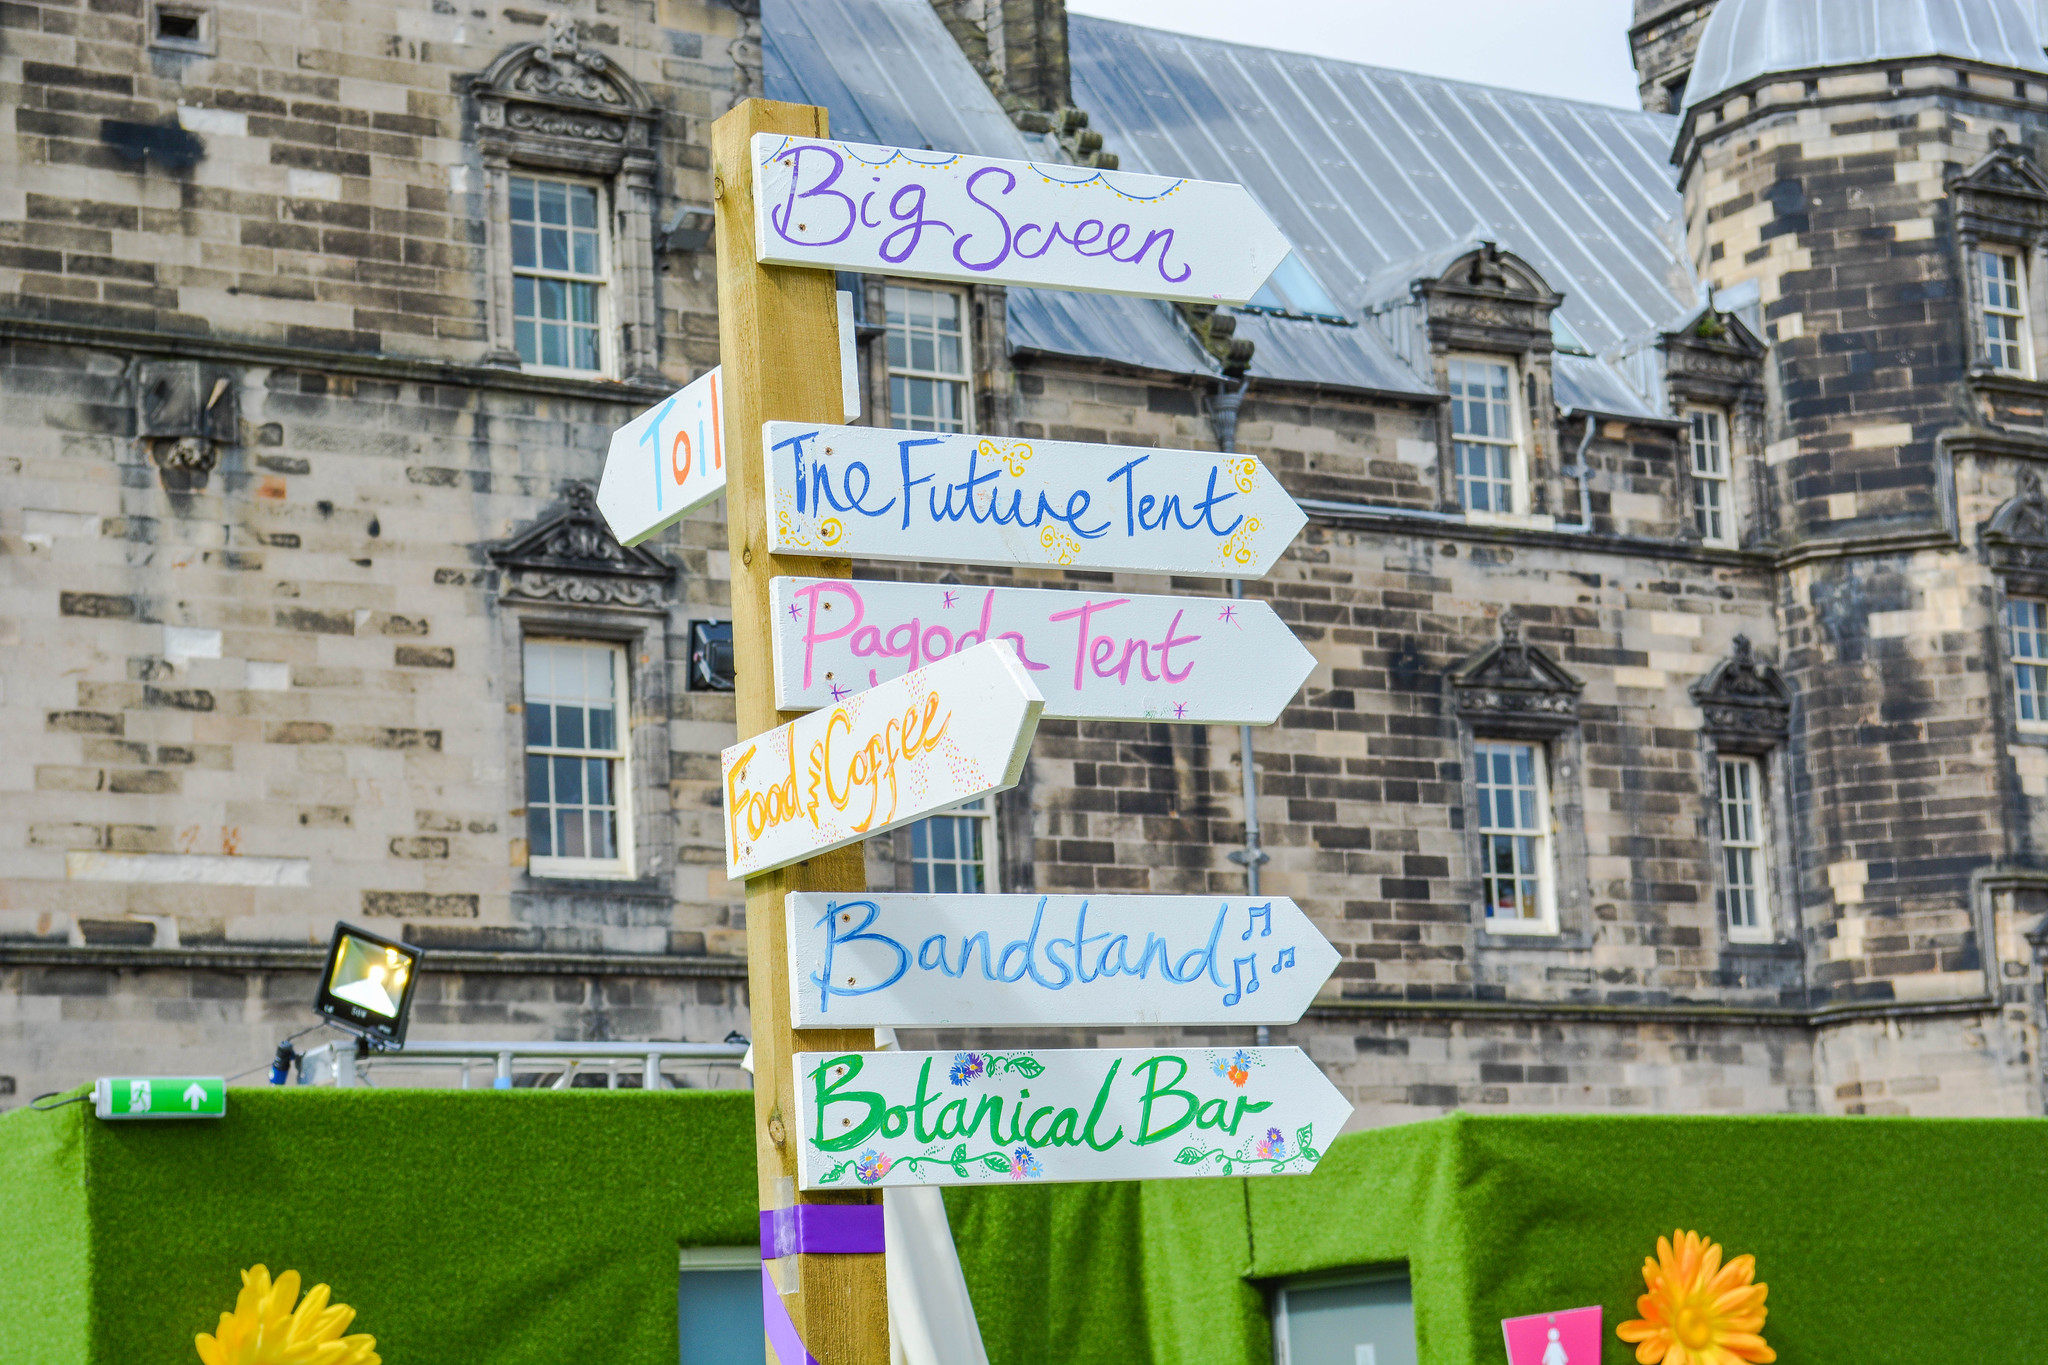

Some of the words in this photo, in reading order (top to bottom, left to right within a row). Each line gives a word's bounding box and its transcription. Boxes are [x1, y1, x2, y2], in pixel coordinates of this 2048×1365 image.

[771, 145, 955, 264] Big
[952, 166, 1191, 283] Screen
[897, 436, 1112, 539] Future
[1107, 454, 1244, 537] Tent
[1048, 598, 1201, 691] Tent
[728, 721, 805, 866] Food
[825, 691, 952, 832] Coffee
[810, 896, 1230, 1013] Bandstand
[808, 1053, 1126, 1152] Botanical
[1130, 1055, 1274, 1147] Bar
